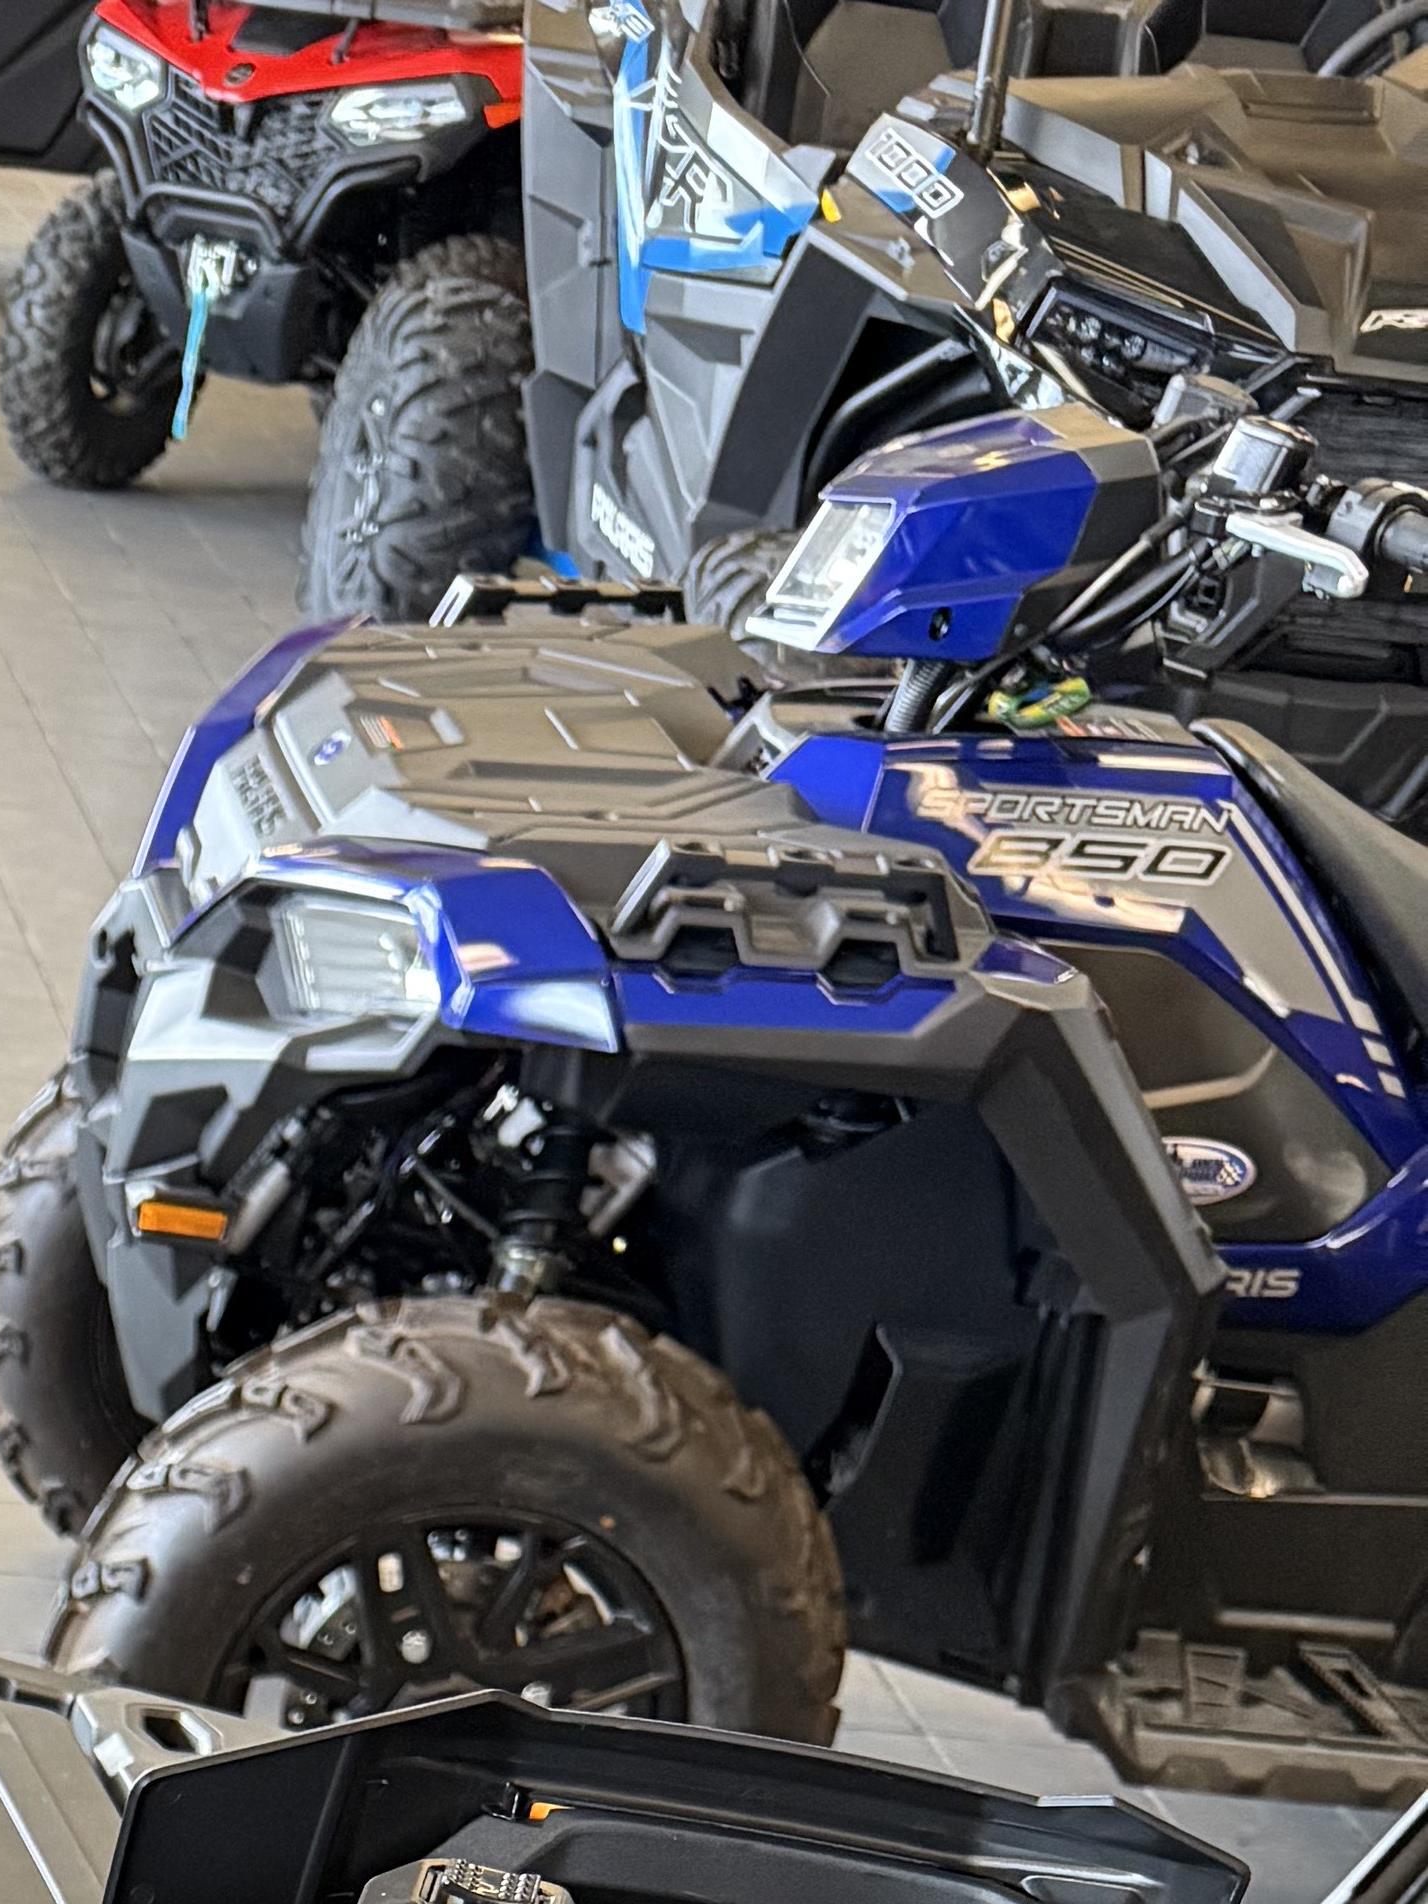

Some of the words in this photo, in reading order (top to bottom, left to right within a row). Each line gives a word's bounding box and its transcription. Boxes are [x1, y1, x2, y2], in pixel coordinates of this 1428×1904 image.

[867, 127, 964, 219] 1000
[916, 788, 1229, 833] SPORTSMAN
[967, 829, 1232, 887] 850
